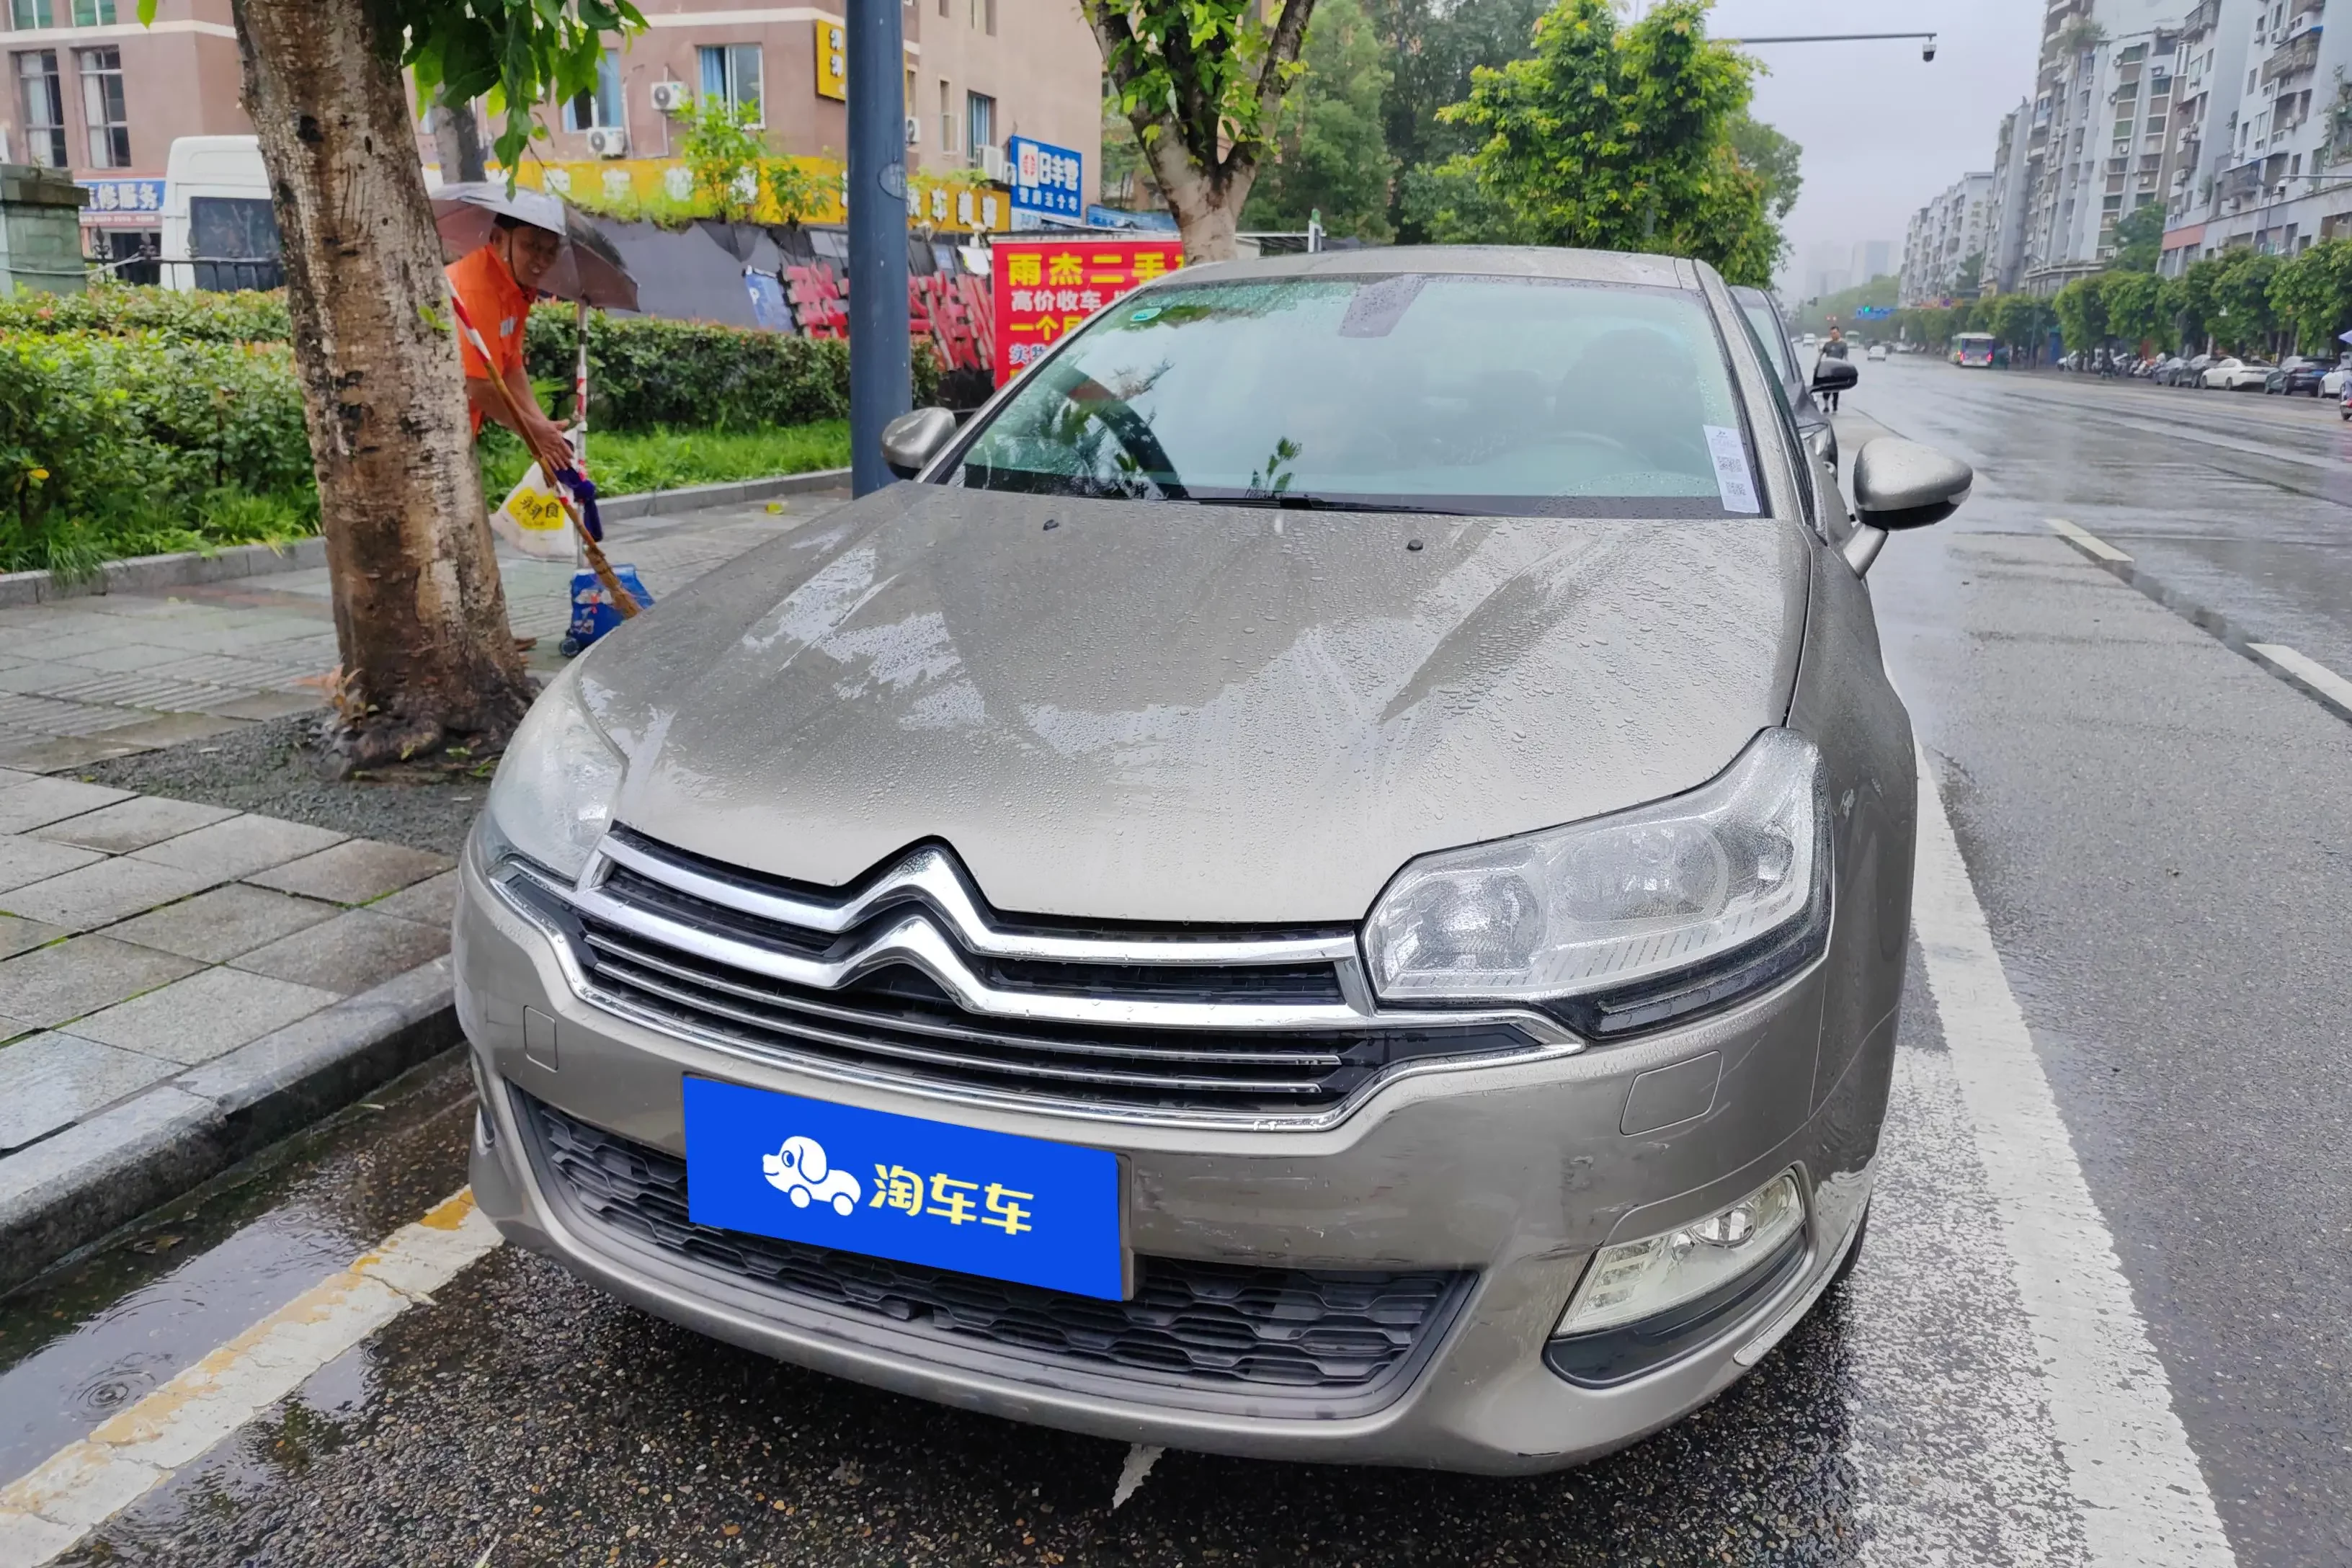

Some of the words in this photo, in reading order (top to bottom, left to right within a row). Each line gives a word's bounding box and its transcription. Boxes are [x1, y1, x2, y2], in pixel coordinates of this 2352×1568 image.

[1038, 151, 1079, 192] 日丰管
[1007, 252, 1185, 286] 雨杰二手
[1011, 290, 1102, 312] 高价收车
